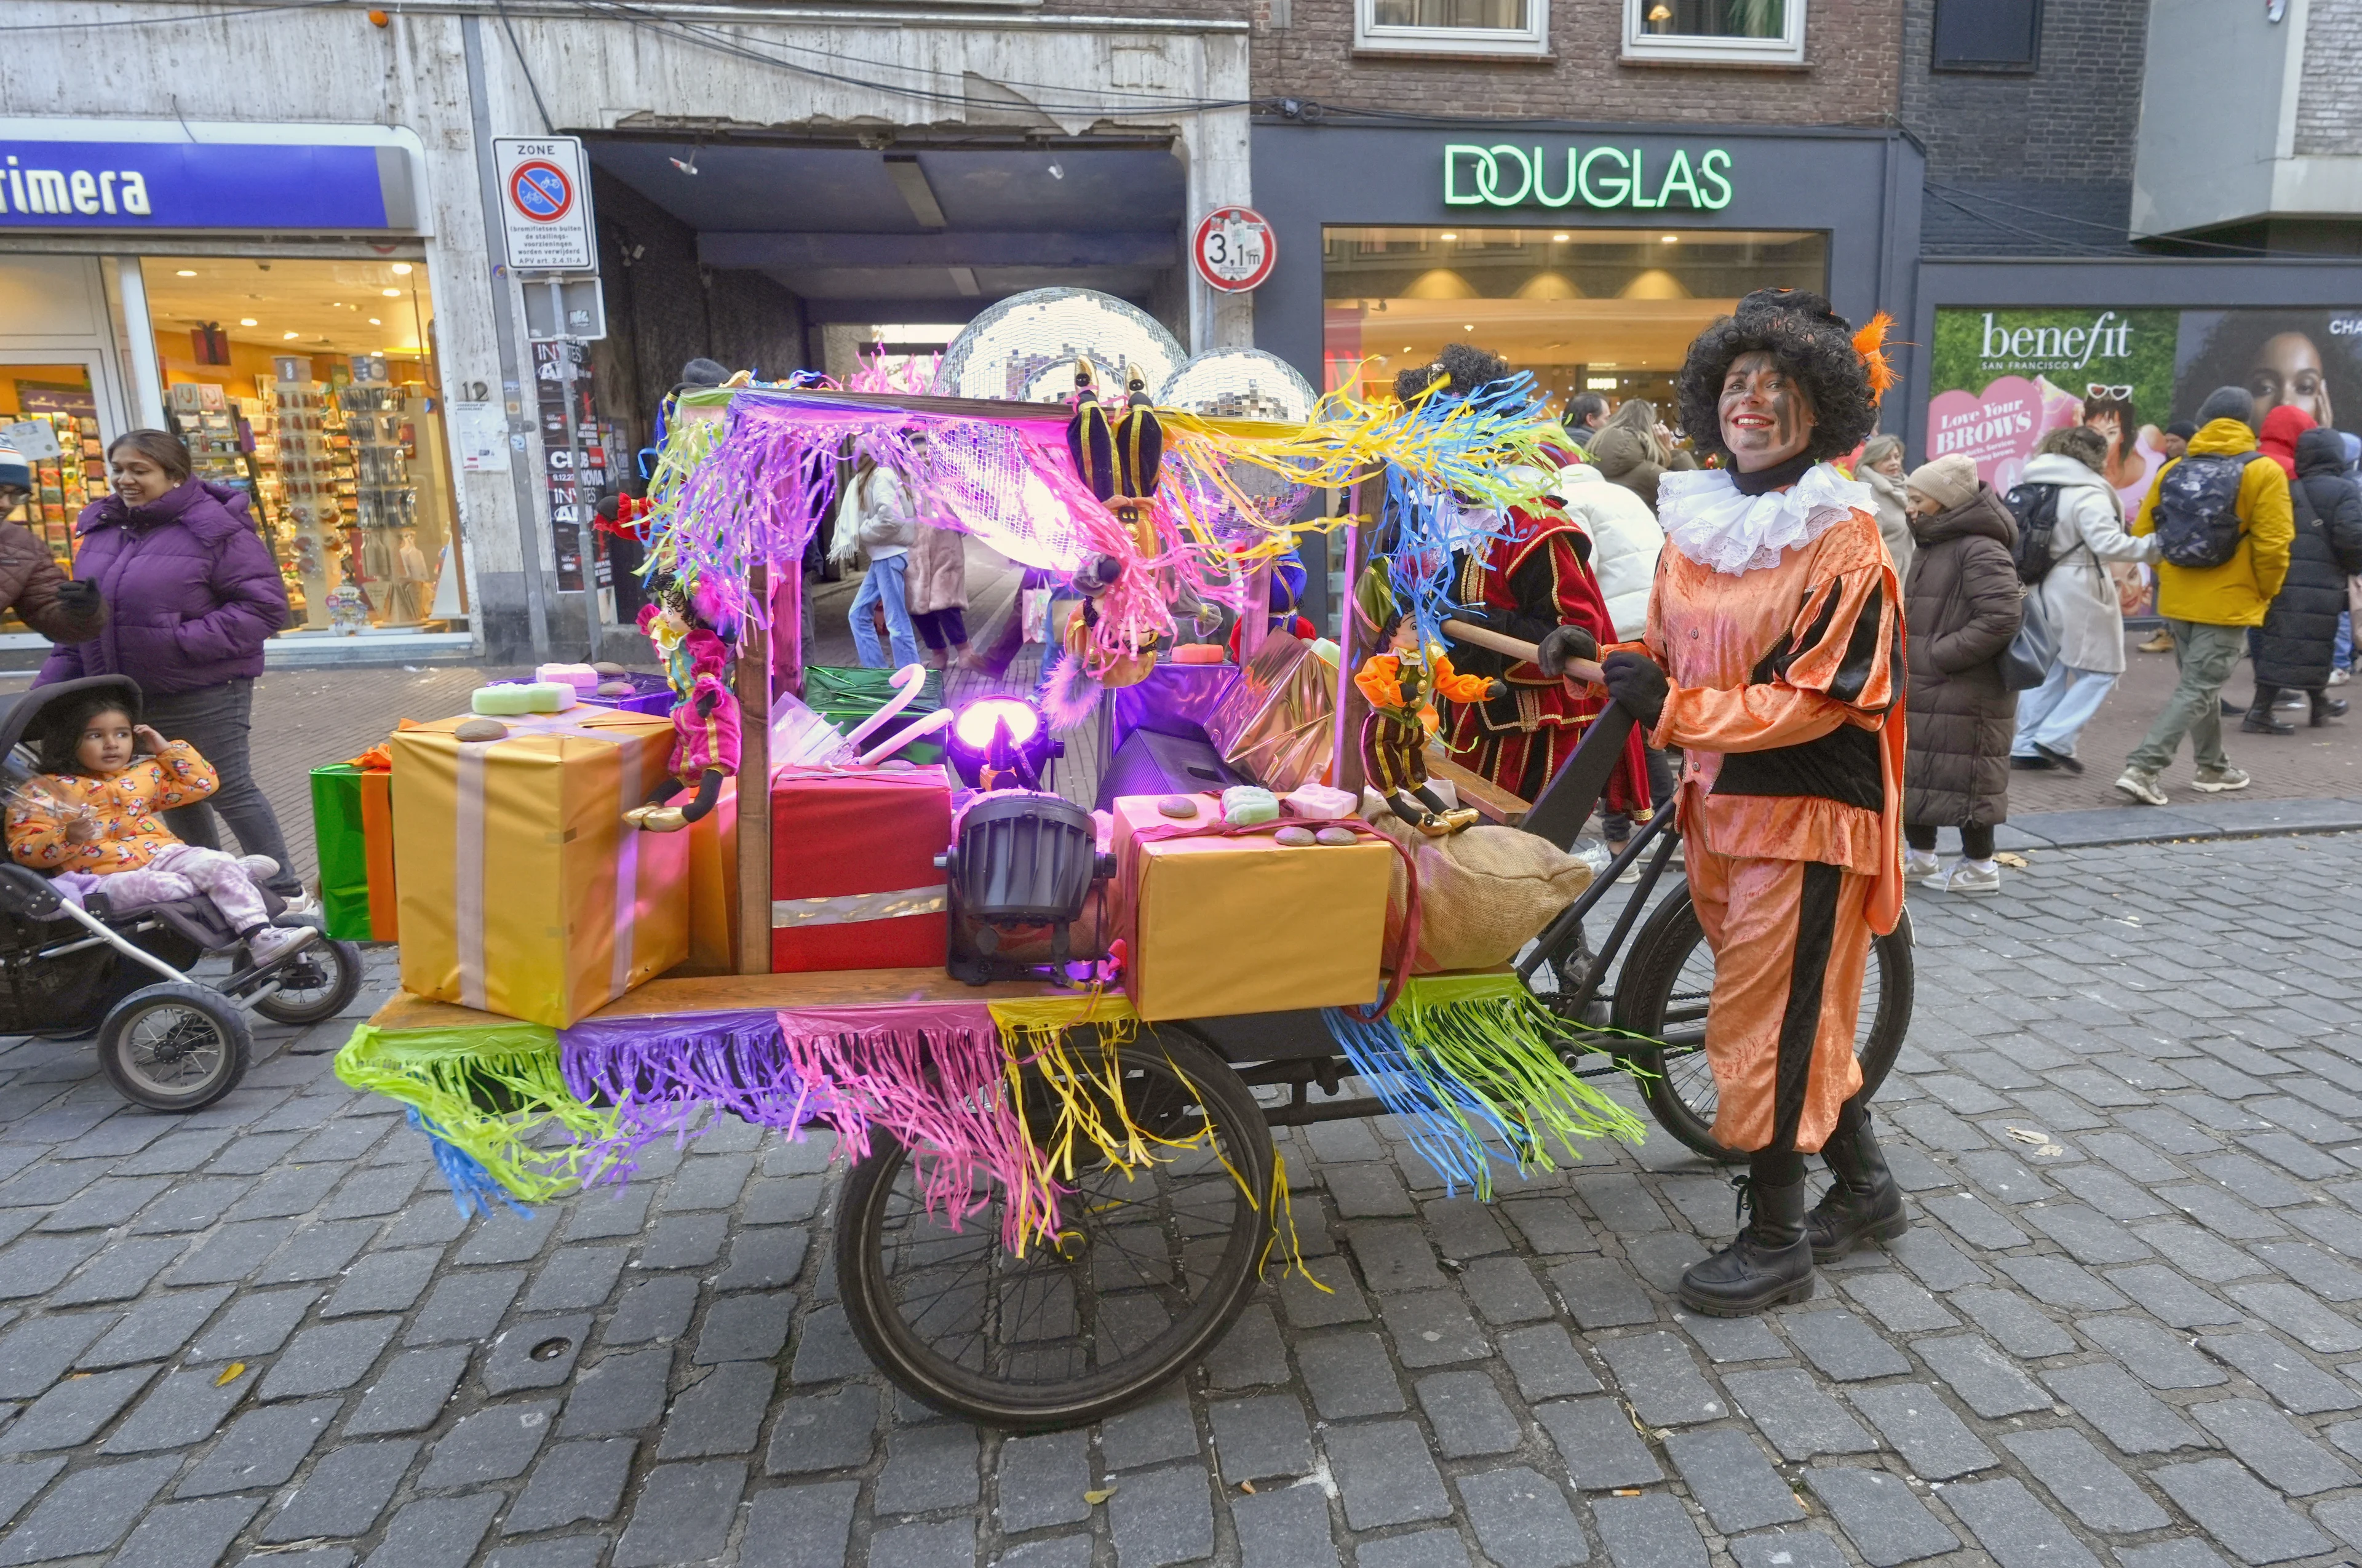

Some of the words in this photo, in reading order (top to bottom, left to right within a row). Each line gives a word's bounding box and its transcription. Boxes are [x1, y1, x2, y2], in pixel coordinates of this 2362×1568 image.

[517, 145, 555, 154] ZONE
[1444, 145, 1733, 210] DOUGLAS
[1979, 311, 2134, 370] benefit
[2008, 361, 2070, 370] FRANCISCO
[463, 381, 490, 402] 12
[1941, 411, 1980, 430] Love
[1982, 399, 2024, 418] Your
[1936, 410, 2032, 455] BROWS
